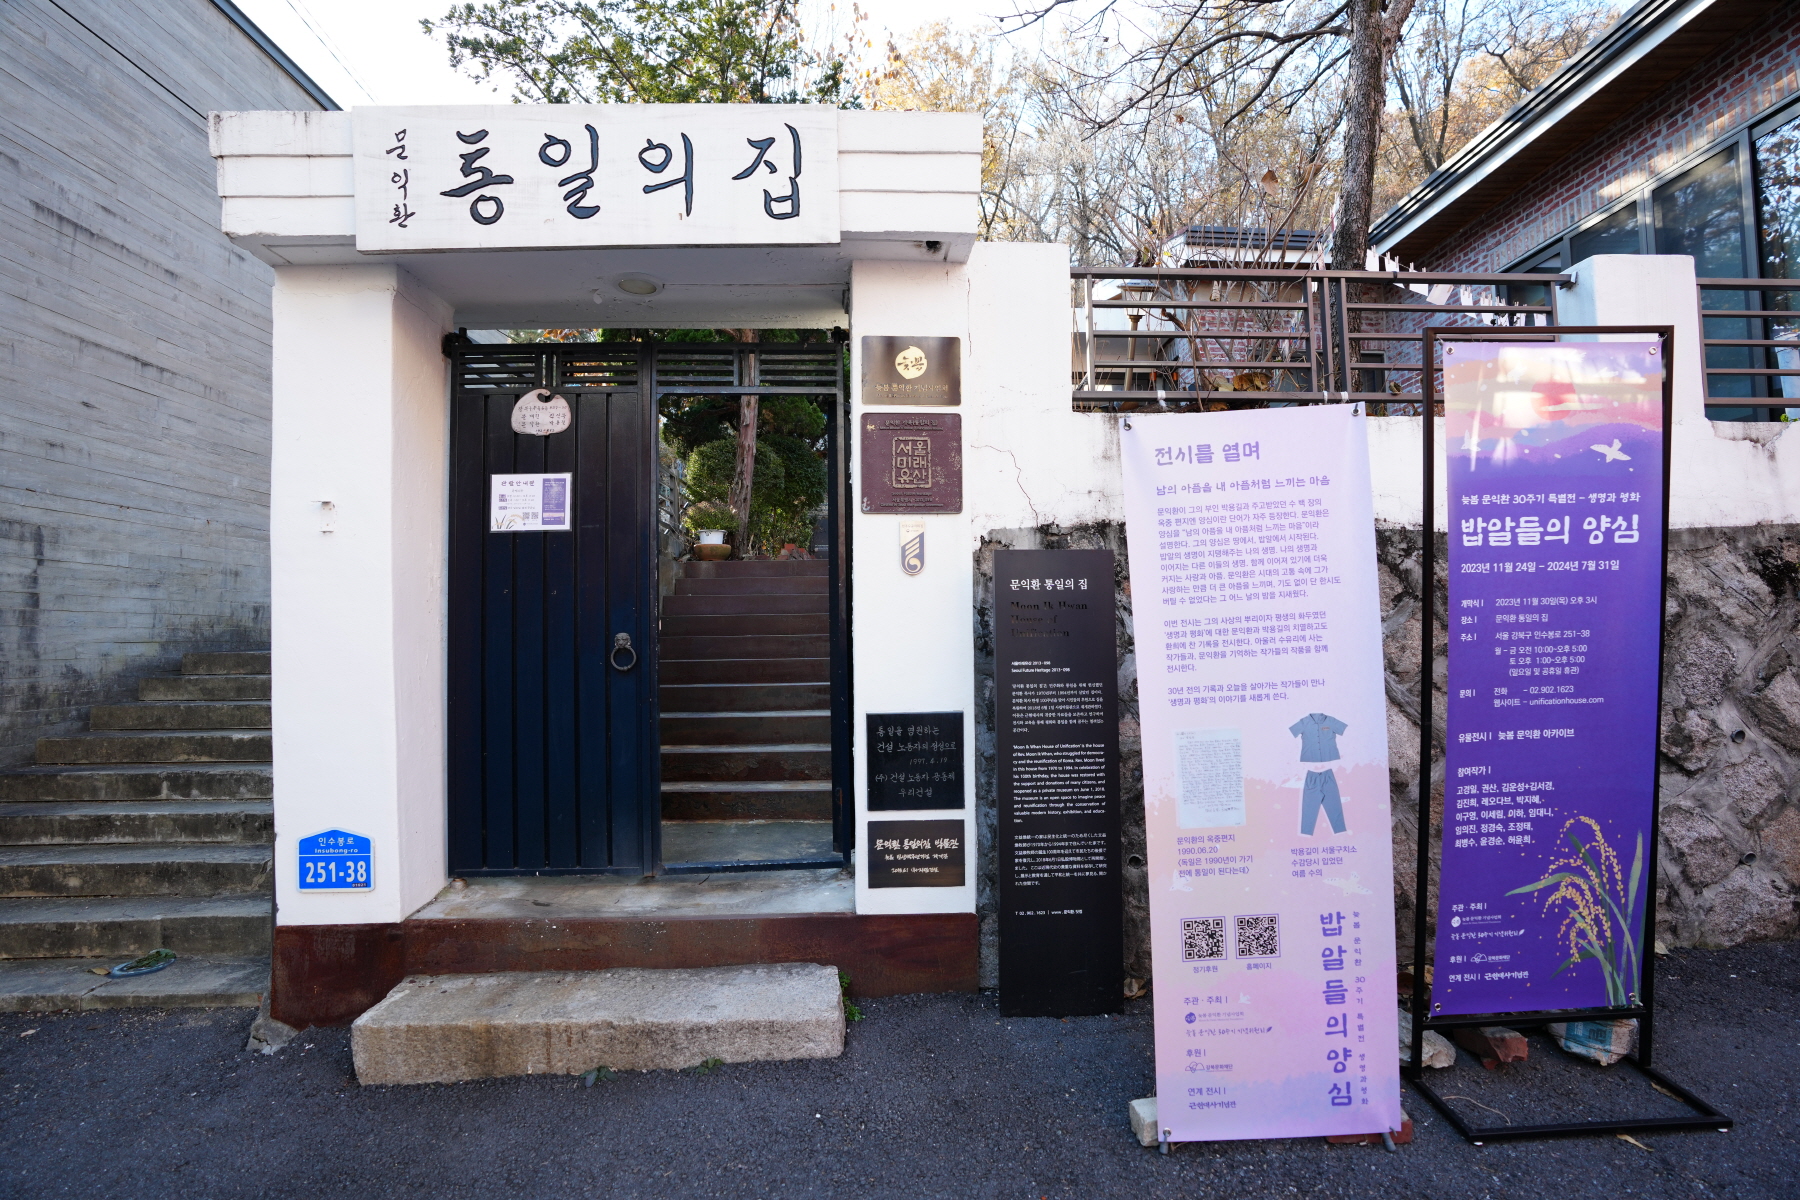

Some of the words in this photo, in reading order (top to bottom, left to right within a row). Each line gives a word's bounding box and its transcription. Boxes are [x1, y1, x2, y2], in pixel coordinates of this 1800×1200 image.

[386, 129, 415, 228] 문익환
[897, 441, 926, 455] 서울
[1154, 444, 1214, 466] 전시를
[1222, 441, 1260, 462] 열며
[897, 457, 926, 468] 미래
[898, 468, 926, 483] 유산
[1156, 484, 1177, 496] 남의
[1181, 482, 1212, 494] 아픔을
[1216, 482, 1226, 492] 내
[1230, 479, 1271, 491] 아픔처럼
[1275, 477, 1306, 488] 느끼는
[1309, 475, 1330, 486] 마음
[1462, 495, 1479, 505] 늦봄
[1481, 494, 1510, 504] 문익환
[1513, 494, 1545, 504] 30주기
[1548, 493, 1576, 503] 특별전
[1588, 493, 1617, 503] 생명과
[1620, 492, 1641, 502] 평화
[1158, 507, 1186, 516] 문익환이
[1205, 505, 1219, 513] 부인
[1221, 503, 1249, 511] 박용길과
[1252, 500, 1286, 509] 주고받았던
[1229, 514, 1250, 522] 단어가
[1253, 513, 1266, 521] 자주
[1301, 509, 1329, 518] 문익환은
[1202, 527, 1223, 535] 아픔을
[1462, 515, 1570, 546] 밥알들의
[1583, 515, 1639, 544] 양심
[1461, 563, 1490, 573] 2023년
[1493, 562, 1513, 572] 11월
[1515, 562, 1536, 572] 24일
[1547, 561, 1578, 571] 2024년
[1582, 561, 1596, 571] 7월
[1598, 560, 1619, 570] 31일
[1010, 579, 1041, 590] 문익환
[1044, 579, 1074, 590] 통일의
[1078, 578, 1088, 589] 집
[1011, 602, 1039, 610] Moon
[1461, 600, 1479, 608] 개막식
[1496, 598, 1520, 606] 2023년
[1570, 596, 1584, 604] 오후
[1586, 596, 1597, 604] 3시
[1164, 620, 1178, 628] 이번
[1181, 618, 1202, 627] 전시는
[1221, 616, 1242, 625] 사상의
[1461, 616, 1473, 624] 장소
[1495, 615, 1516, 623] 문익환
[1518, 614, 1539, 622] 통일의
[1541, 614, 1548, 622] 집
[1495, 632, 1509, 640] 서울
[1511, 631, 1532, 640] 강북구
[1534, 630, 1561, 639] 인수봉로
[1563, 630, 1590, 638] 251-38
[1518, 646, 1532, 654] 오전
[1572, 645, 1587, 653] 5:00
[1569, 656, 1585, 664] 5:00
[1509, 668, 1531, 676] (일요일
[1542, 667, 1561, 676] 공휴일
[1564, 666, 1579, 675] 휴관)
[1186, 686, 1201, 694] 전의
[1203, 685, 1224, 693] 기록과
[1226, 684, 1247, 692] 오늘을
[1250, 682, 1278, 691] 살아가는
[1310, 679, 1325, 687] 만나
[1460, 690, 1471, 698] 문의
[1494, 687, 1507, 695] 전화
[1529, 686, 1574, 694] 02.902.1623
[1493, 699, 1521, 707] 웹사이트
[1529, 697, 1604, 705] unificationhouse.com
[876, 726, 902, 737] 통일을
[1459, 732, 1486, 743] 유물전시
[1498, 731, 1514, 740] 늦봄
[1516, 730, 1541, 739] 문익환
[1543, 729, 1575, 738] 아카이브
[877, 741, 893, 752] 건설
[897, 742, 928, 751] 노동자의
[931, 741, 956, 751] 정성으로
[891, 772, 905, 782] 건설
[907, 772, 929, 782] 노동자
[932, 771, 955, 781] 공동체
[1458, 766, 1486, 777] 참여작가
[899, 787, 932, 797] 우리건설
[1457, 785, 1479, 795] 고경일,
[1482, 784, 1499, 793] 권산,
[1502, 782, 1554, 792] 김운성+김서경,
[1481, 797, 1513, 806] 레오다브,
[1516, 795, 1541, 804] 박지혜,
[1456, 812, 1478, 821] 이구영,
[1481, 823, 1505, 833] 정경숙,
[1508, 822, 1533, 831] 조정태,
[318, 837, 354, 846] 인수봉로
[1177, 836, 1205, 845] 문익환의
[1207, 835, 1235, 843] 옥중편지
[1455, 838, 1477, 848] 최병수,
[1178, 846, 1218, 855] 1990.06.20
[1291, 846, 1319, 855] 박용길이
[1321, 845, 1357, 854] 서울구치소
[1205, 856, 1236, 865] 1990년이
[1239, 855, 1253, 863] 가기
[1291, 858, 1319, 867] 수감당시
[1321, 857, 1343, 865] 입었던
[306, 861, 366, 883] 251-38
[1195, 868, 1216, 876] 통일이
[1292, 869, 1306, 878] 여름
[1308, 868, 1322, 877] 수의
[1193, 966, 1218, 974] 정기후원
[1320, 911, 1348, 1037] 밥알들의
[1327, 1047, 1352, 1106] 양심
[1188, 1088, 1203, 1096] 연계
[1206, 1087, 1220, 1095] 전시
